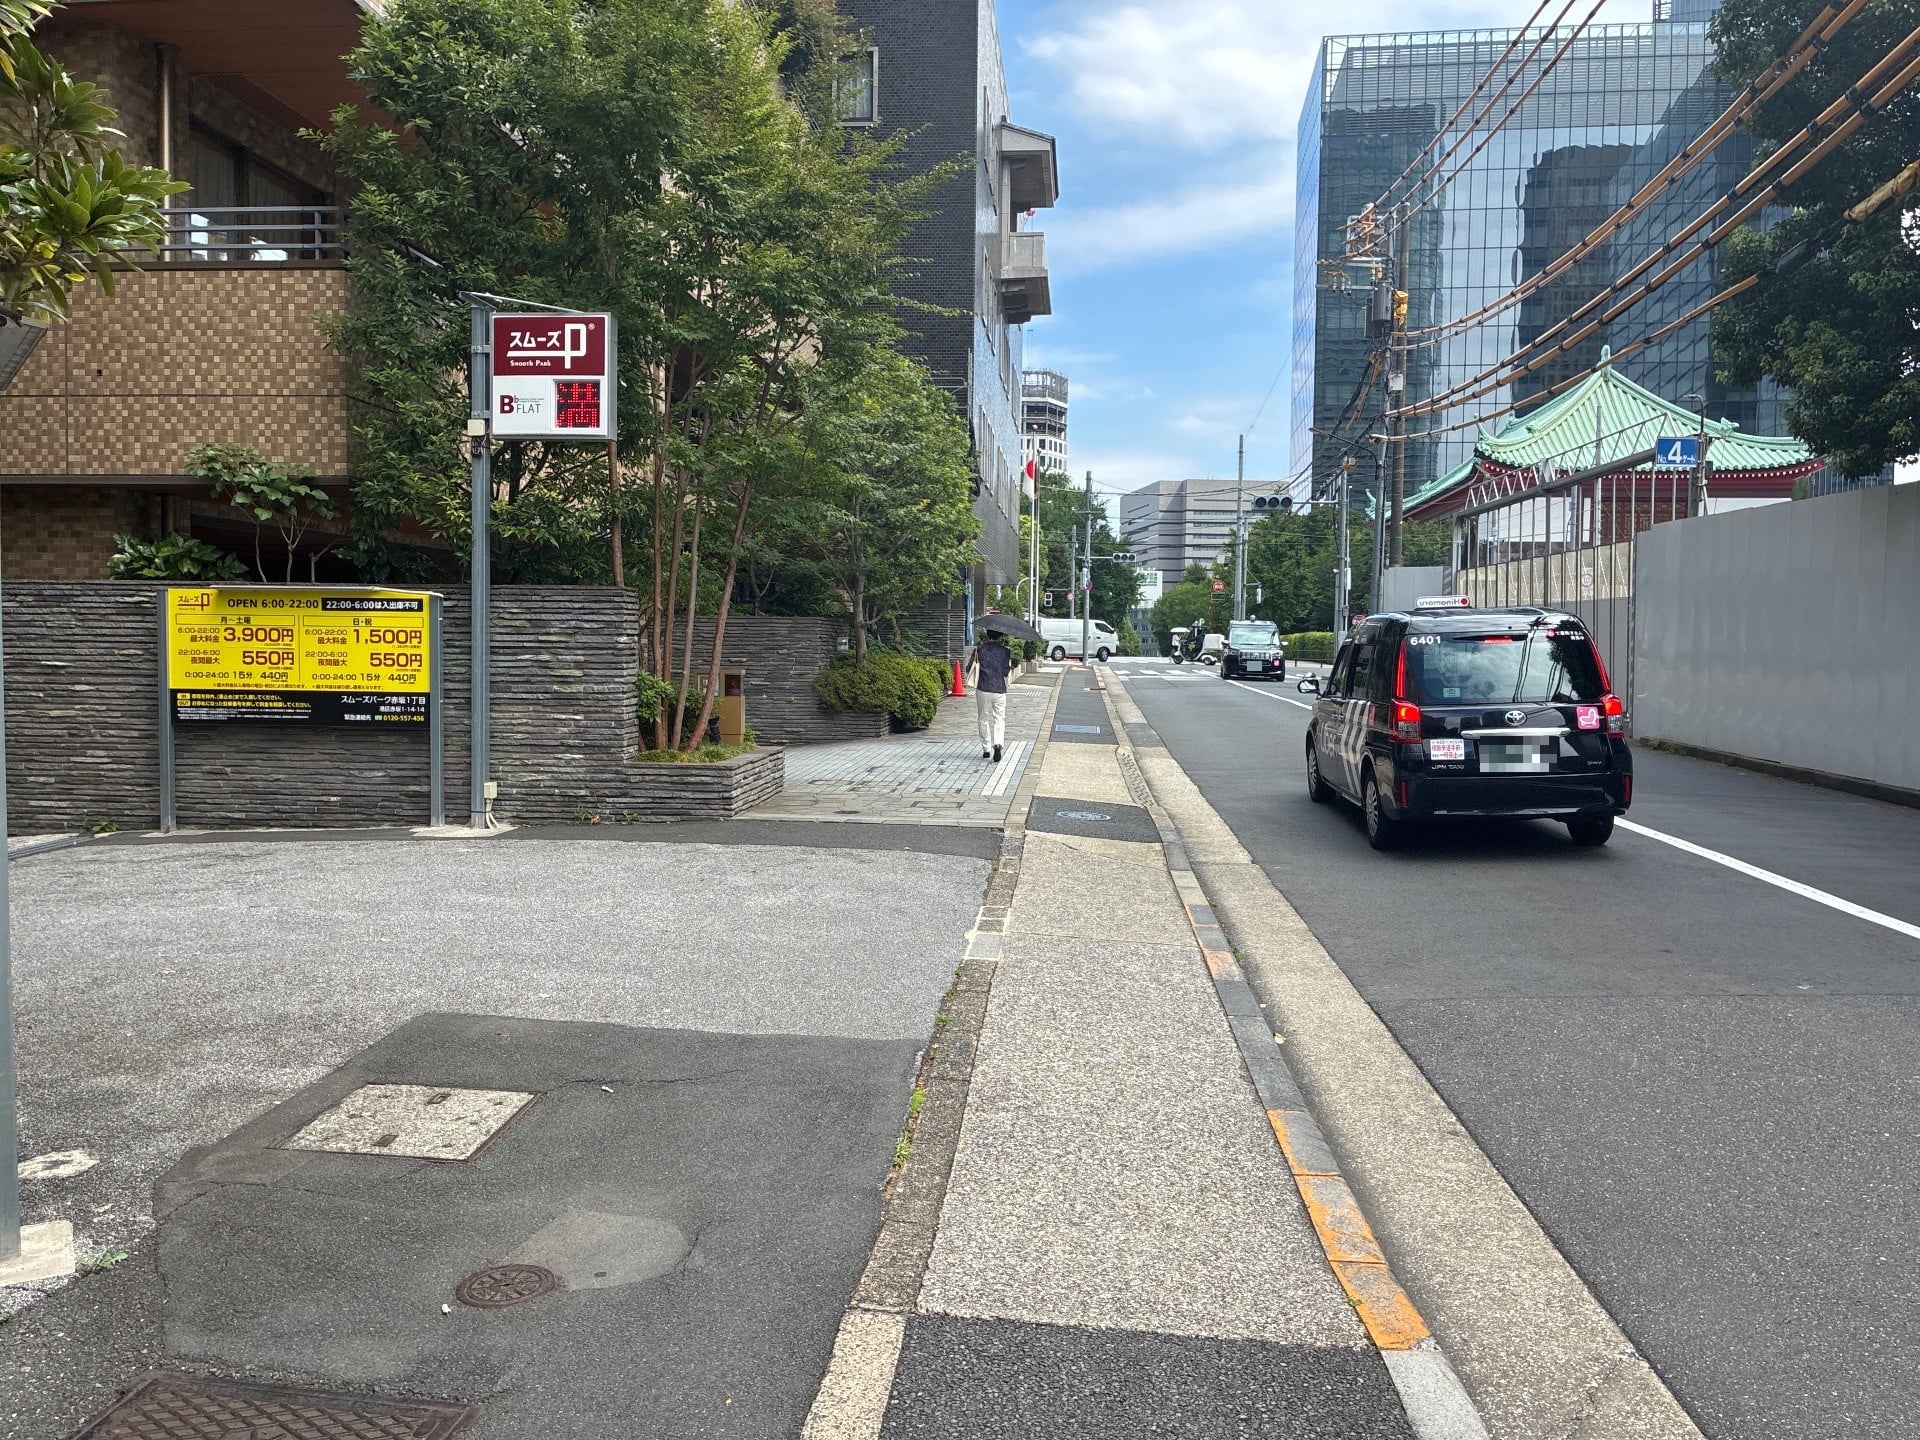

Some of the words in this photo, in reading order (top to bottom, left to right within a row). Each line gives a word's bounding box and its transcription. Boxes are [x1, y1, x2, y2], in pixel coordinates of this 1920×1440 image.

[510, 330, 562, 348] スムーズ
[517, 404, 541, 414] FLAT
[556, 383, 600, 428] 満
[1668, 441, 1683, 464] 4
[228, 599, 258, 608] OPEN
[262, 599, 319, 609] 6:00-22:00
[326, 600, 418, 610] 22:00-6:00は入出庫不可
[190, 635, 220, 643] 最大料金
[223, 627, 294, 643] 3,900円
[353, 629, 422, 645] 1,500円
[317, 637, 347, 645] 最大料金
[1410, 636, 1441, 645] 6401
[190, 656, 221, 665] 夜間最大
[242, 650, 295, 666] 550円
[318, 658, 348, 667] 夜間最大
[370, 652, 422, 668] 550円
[185, 671, 229, 679] 0:00-24:00
[312, 673, 357, 681] 0:00-24:00
[341, 695, 426, 705] スムーズパーク赤坂1丁目
